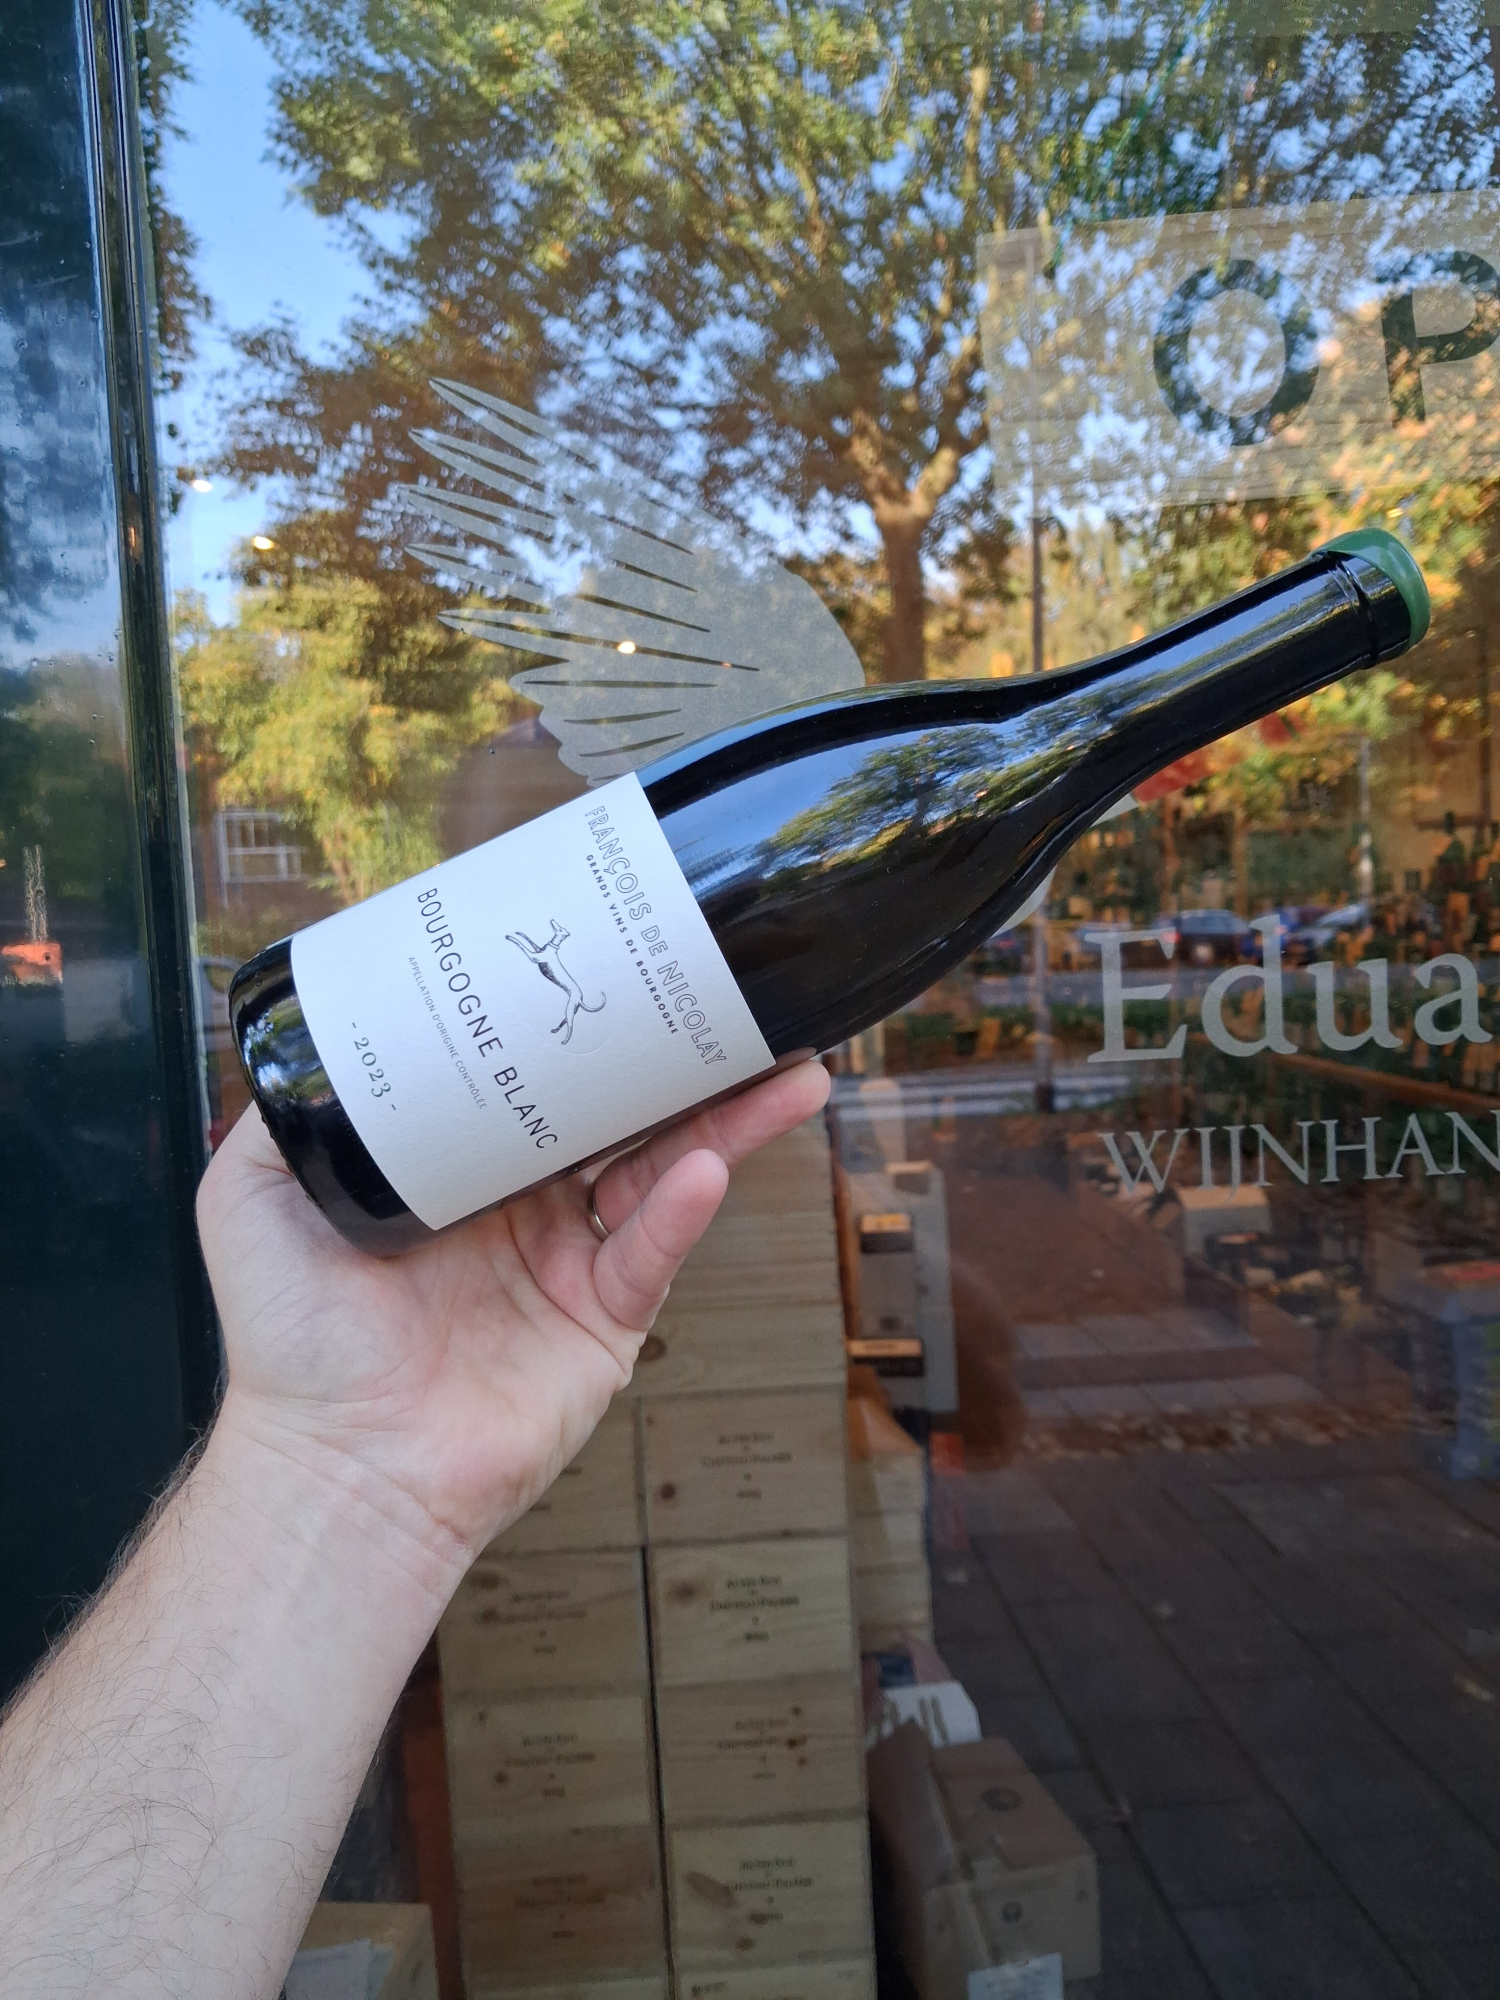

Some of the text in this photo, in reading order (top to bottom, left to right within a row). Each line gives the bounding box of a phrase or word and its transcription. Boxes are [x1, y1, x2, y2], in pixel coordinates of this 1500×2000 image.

[1153, 250, 1500, 447] OP
[408, 956, 488, 1109] APPELLATION D'ORIGINE CONTRÔLÉE
[417, 888, 558, 1149] BOURGOGNE BLANC
[585, 806, 727, 1065] FRANÇOIS DE NICOLAY
[586, 854, 679, 1034] GRANDS VINS DE BOURGOGNE
